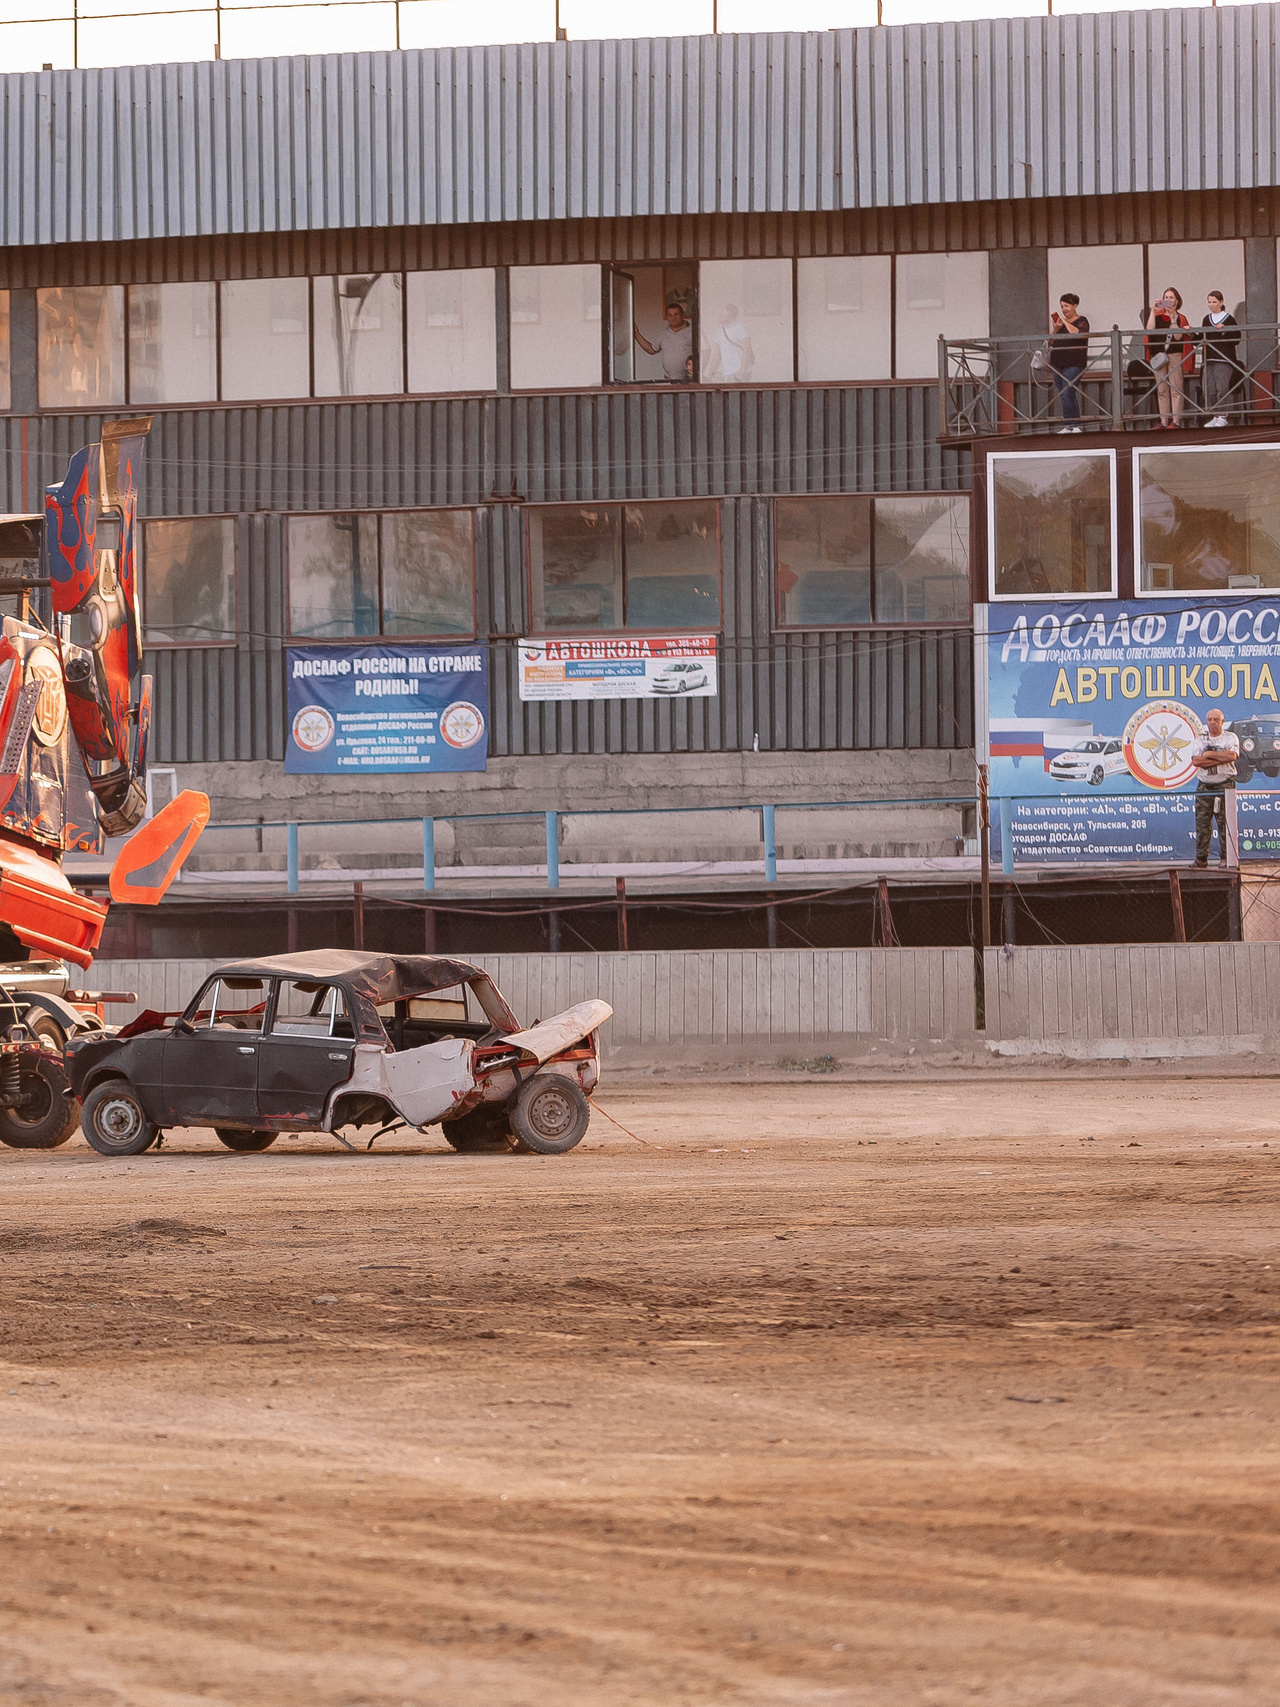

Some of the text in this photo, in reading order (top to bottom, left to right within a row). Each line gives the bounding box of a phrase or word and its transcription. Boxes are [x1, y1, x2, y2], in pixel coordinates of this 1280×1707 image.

[1000, 613, 1167, 662] ДОСААФ
[548, 640, 652, 660] АВТОШКОЛА
[1045, 650, 1081, 664] ГОРДОСТЬ
[1082, 649, 1091, 660] ЗА
[1126, 647, 1186, 660] ОТВЕТСТВЕННОСТЬ
[1187, 647, 1196, 659] ЗА
[1196, 646, 1235, 660] НАСТОЯЩЕЕ,
[292, 655, 482, 678] ДОСААФ РОССИИ НА СТРАЖЕ
[355, 678, 419, 697] РОДИНЫ!
[1050, 663, 1280, 707] АВТОШКОЛА
[1018, 805, 1031, 816] На
[1034, 805, 1089, 817] категории:
[1092, 804, 1117, 816] «А1»,
[1119, 803, 1140, 815] «В»,
[1143, 803, 1168, 815] «В1»,
[1171, 803, 1189, 813] «С»
[1011, 819, 1147, 832] Новосибирск, ул. Тульская, 205
[1011, 833, 1088, 844] отодром ДОСААФ
[1021, 845, 1081, 856] издательство
[1083, 844, 1133, 854] «Советская
[1135, 843, 1173, 854] Сибирь»
